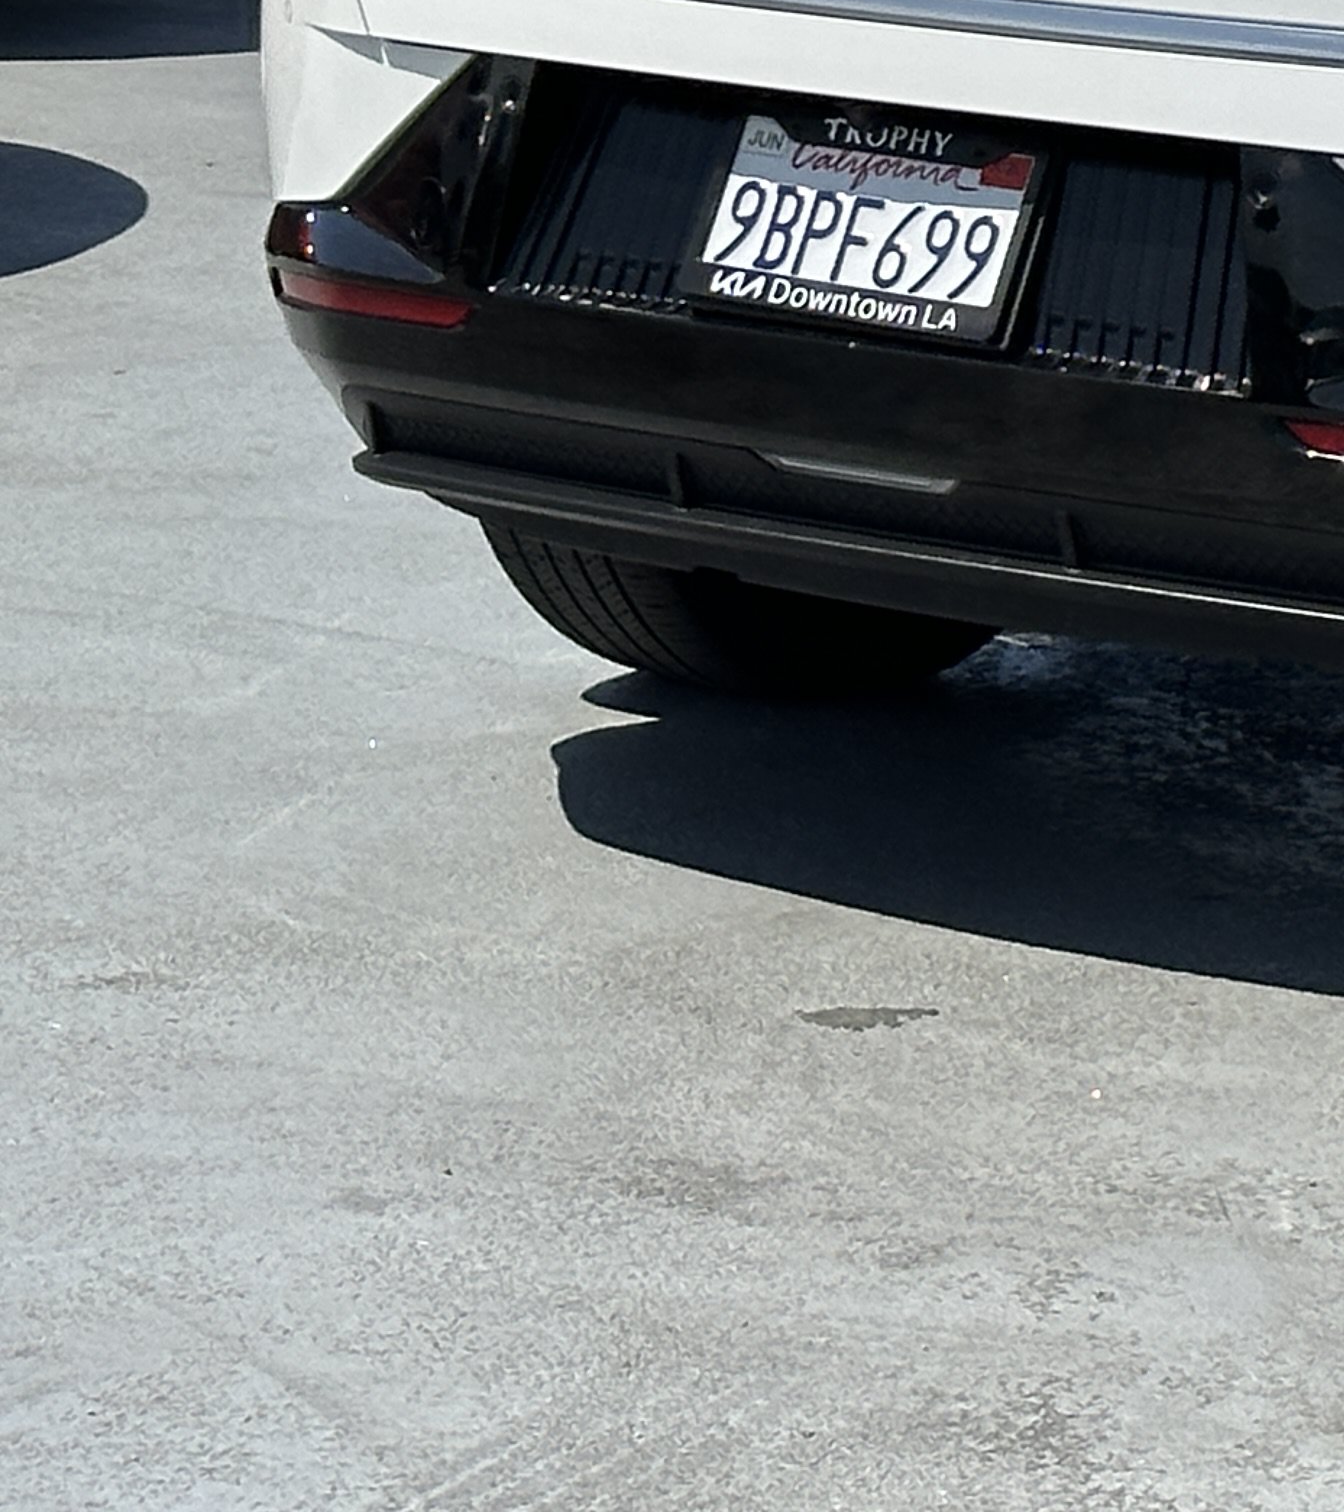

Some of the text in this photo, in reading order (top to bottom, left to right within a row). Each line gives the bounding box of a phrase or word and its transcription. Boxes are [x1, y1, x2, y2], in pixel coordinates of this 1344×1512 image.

[746, 129, 786, 152] JUN
[790, 143, 980, 192] California
[713, 180, 1000, 300] 9BPF699
[710, 269, 957, 331] KIA Downtown LA
